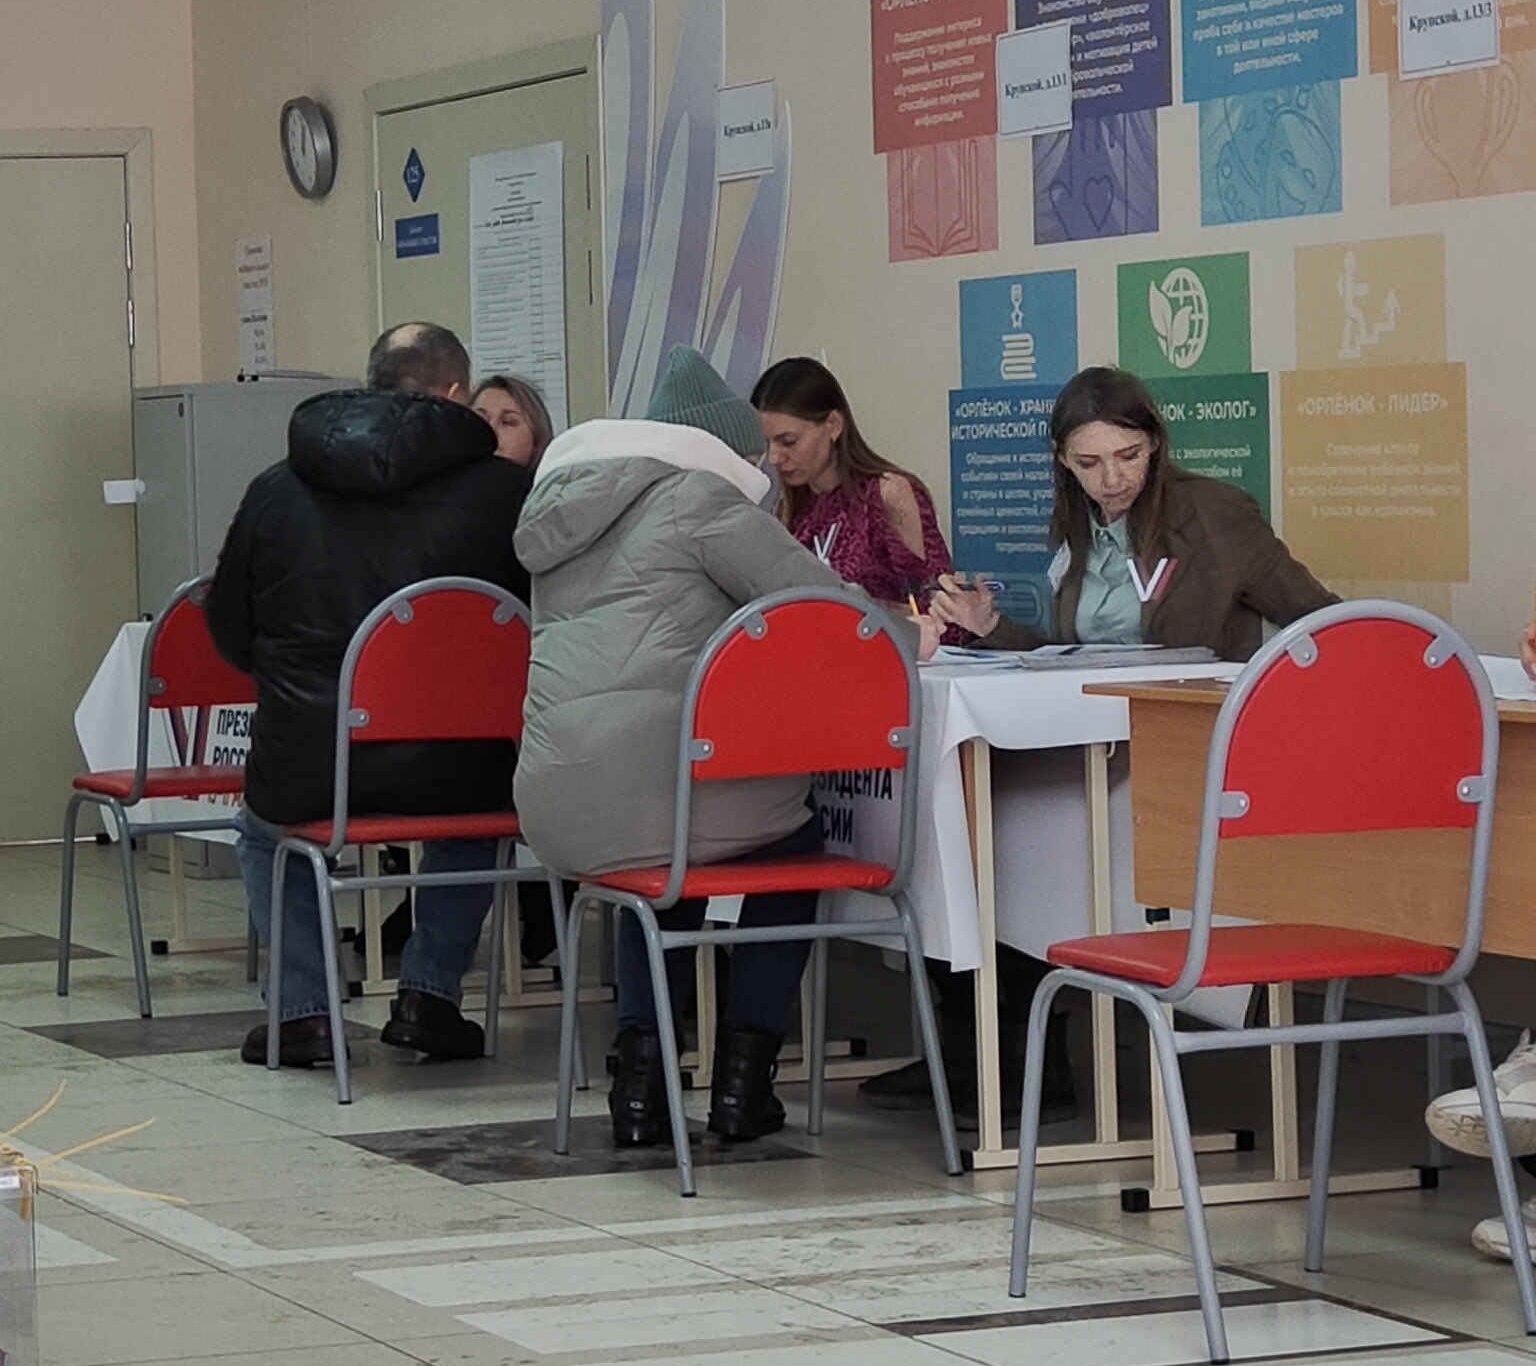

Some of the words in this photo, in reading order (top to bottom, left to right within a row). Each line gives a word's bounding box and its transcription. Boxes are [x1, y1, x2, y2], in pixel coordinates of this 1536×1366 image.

[955, 398, 1012, 419] «ОРЛЁНОК
[1195, 399, 1257, 421] ЭКОЛОГ»
[1297, 391, 1376, 416] «ОРЛЁНОК
[1386, 391, 1449, 416] ЛИДЕР»
[952, 418, 1037, 441] ИСТОРИЧЕСКОЙ
